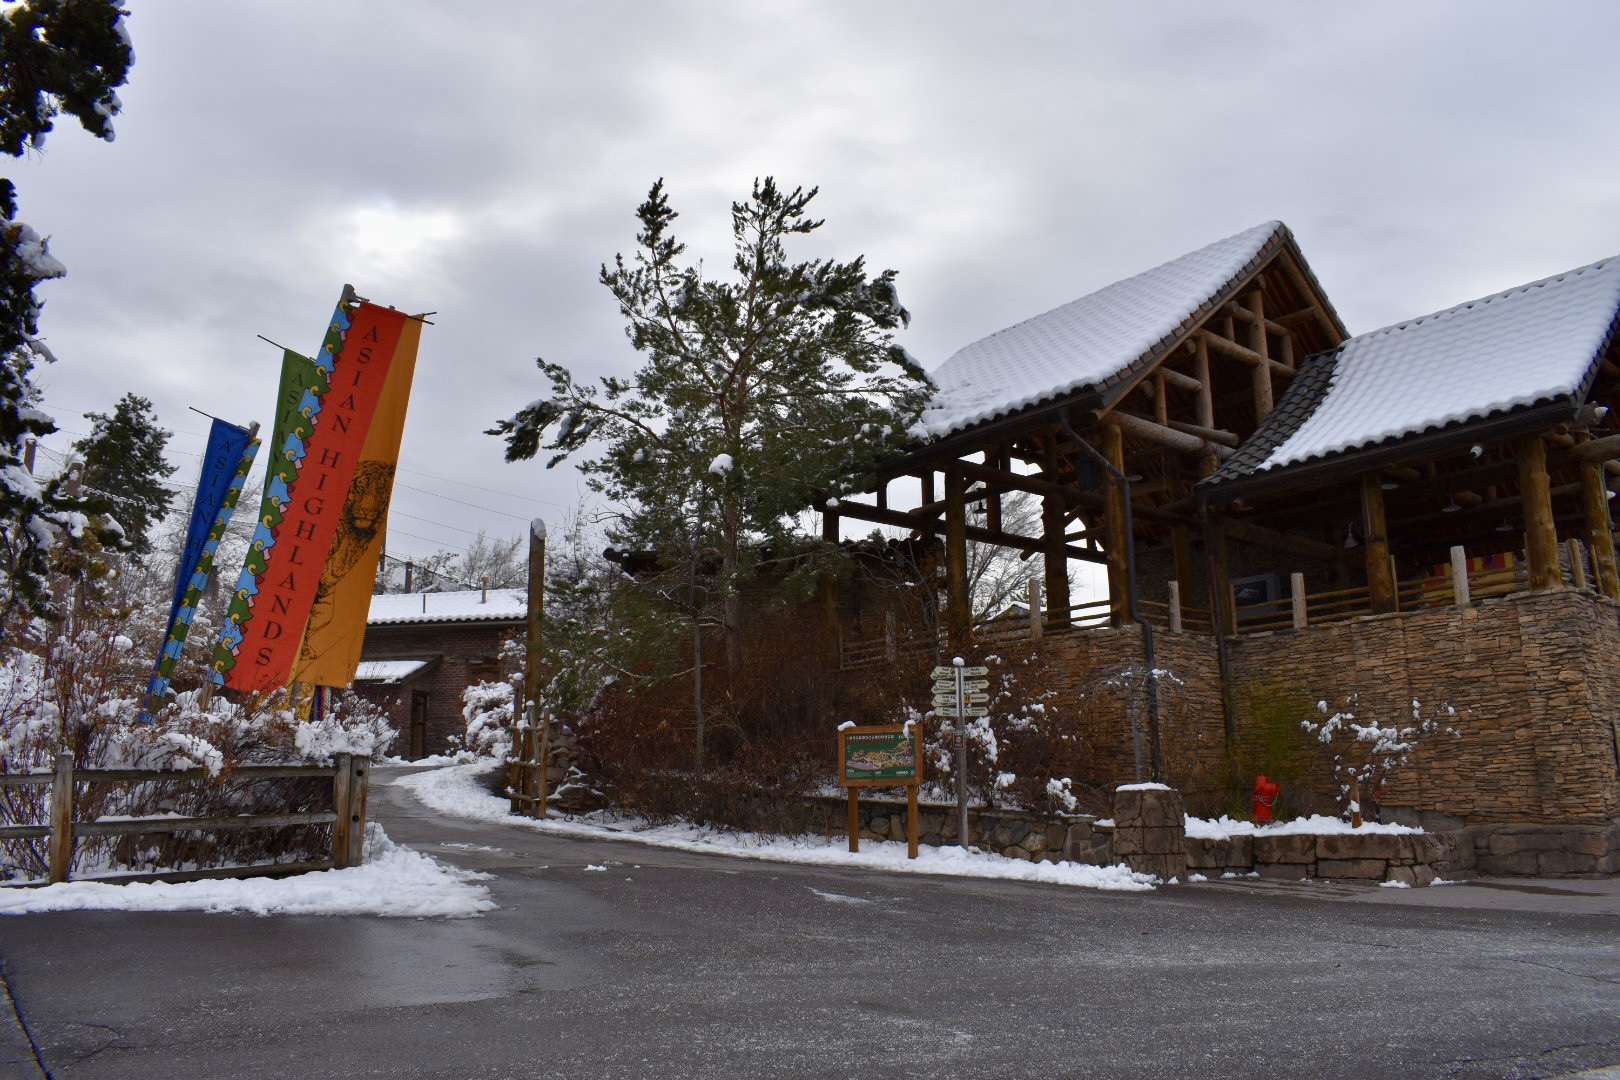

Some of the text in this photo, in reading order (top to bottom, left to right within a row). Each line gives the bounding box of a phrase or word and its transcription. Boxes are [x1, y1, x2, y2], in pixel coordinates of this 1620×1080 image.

[196, 439, 231, 524] ASIAN
[255, 325, 379, 666] ASIAN HIGHLANDS
